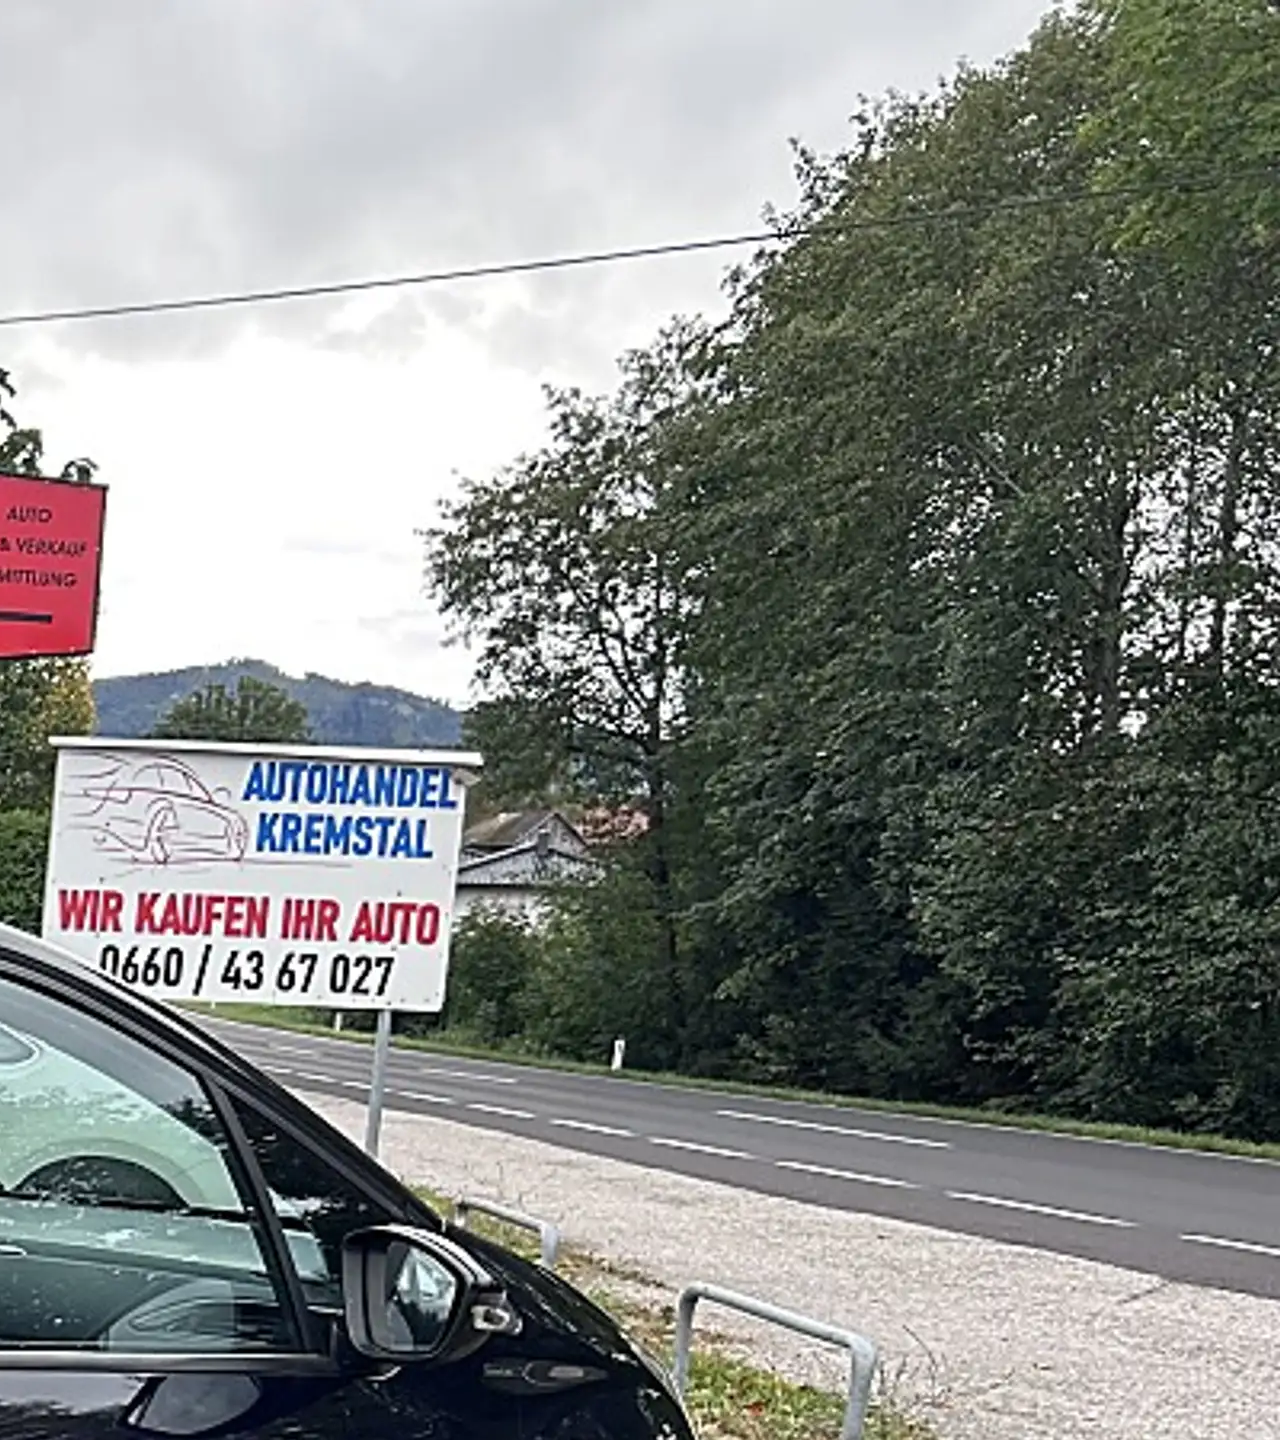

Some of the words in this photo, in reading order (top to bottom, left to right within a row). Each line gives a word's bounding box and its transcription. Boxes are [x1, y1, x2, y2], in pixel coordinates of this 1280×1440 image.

[6, 506, 52, 523] AUTO
[0, 537, 11, 552] &
[16, 537, 88, 558] VERKAUF
[242, 761, 458, 809] AUTOHANDEL
[256, 812, 434, 859] KREMSTAL
[58, 889, 124, 933] WIR
[134, 892, 270, 939] KAUFEN
[280, 898, 340, 942] IHR
[349, 902, 441, 946] AUTO
[99, 944, 184, 988] 0660
[221, 950, 265, 992] 43
[276, 953, 319, 995] 67
[328, 954, 396, 997] 027
